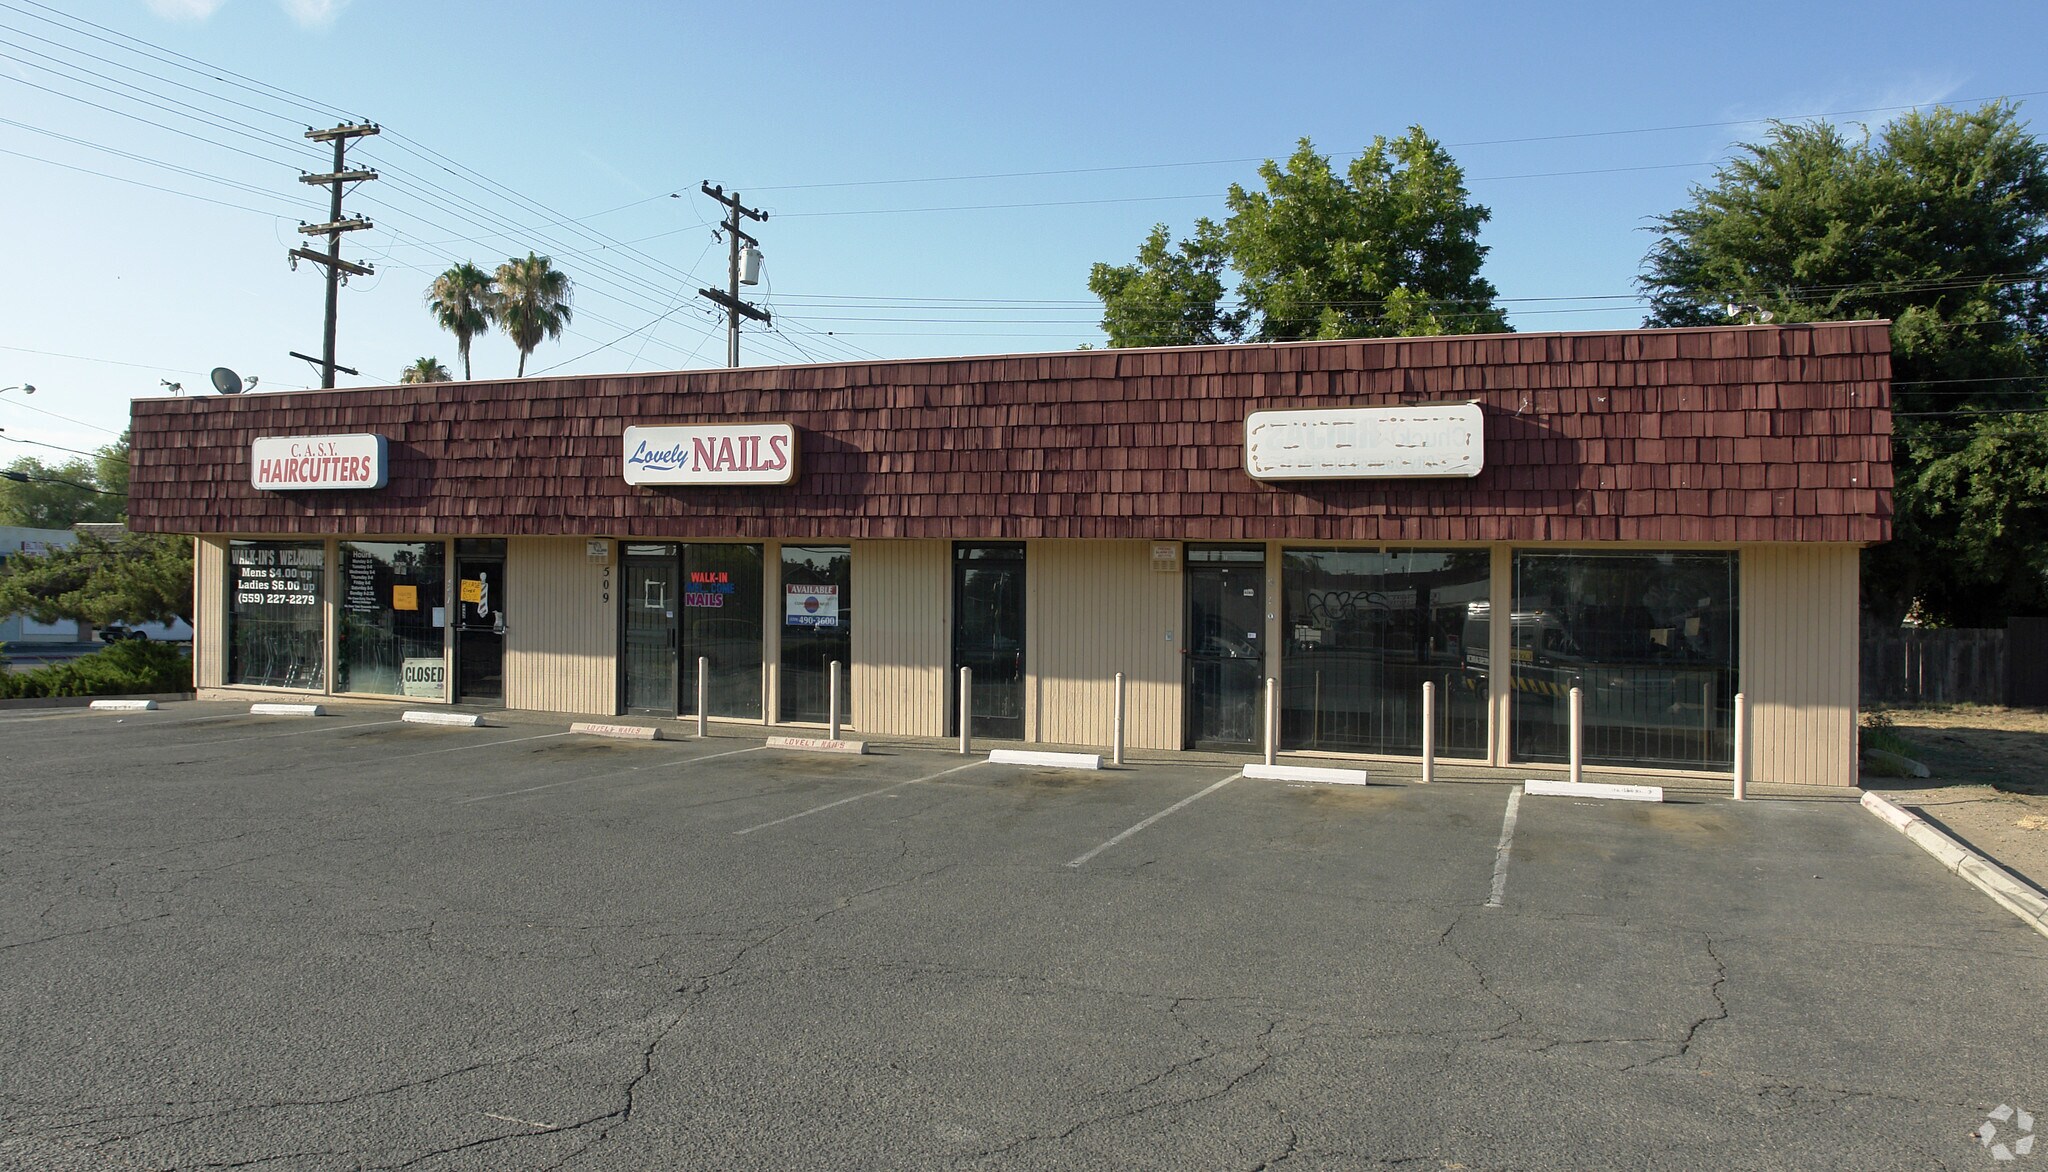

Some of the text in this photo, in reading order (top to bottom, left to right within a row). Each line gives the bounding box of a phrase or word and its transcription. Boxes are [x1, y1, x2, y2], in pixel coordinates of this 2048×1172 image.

[628, 435, 788, 472] Lovely NAILS
[259, 456, 371, 483] HAIRCUTTERS
[231, 549, 323, 566] WALK-IN'S WELCOME
[241, 567, 313, 581] Mens $4.00 up
[691, 572, 728, 583] WALK-IN
[237, 580, 315, 593] Ladies $6.00 up
[791, 585, 834, 595] AVAILABLE
[237, 593, 315, 605] (559) 227-2279
[685, 593, 724, 608] NAILS
[405, 666, 445, 683] CLOSED
